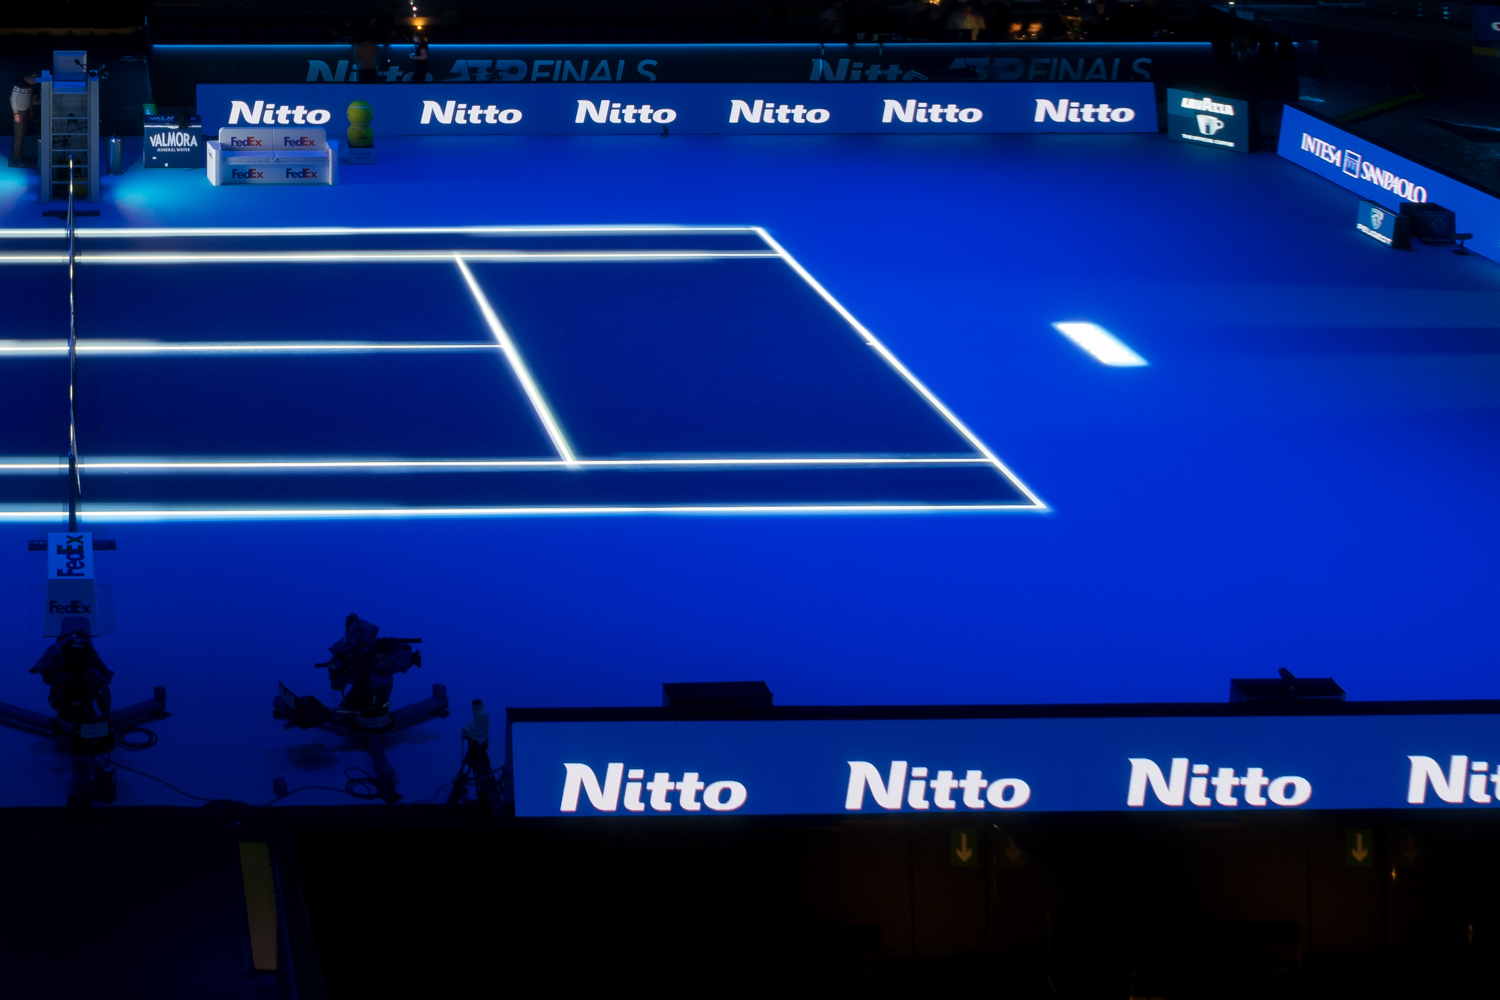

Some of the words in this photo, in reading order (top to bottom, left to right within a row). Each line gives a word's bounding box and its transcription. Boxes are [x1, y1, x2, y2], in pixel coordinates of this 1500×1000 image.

[228, 100, 331, 125] Nitto
[420, 100, 522, 125] Nitto
[575, 100, 677, 124] Nitto
[729, 100, 830, 124] Nitto
[882, 99, 984, 123] Nitto
[1034, 99, 1135, 123] Nitto
[149, 131, 198, 147] VALMORA
[231, 136, 262, 147] FedEx
[284, 136, 316, 147] FedEx
[232, 168, 264, 179] FedEx
[286, 167, 318, 179] FedEx
[1301, 133, 1343, 168] INTESA
[1360, 161, 1428, 203] SANPAOLO
[57, 535, 85, 577] FedEx
[49, 601, 91, 613] FedEx
[560, 763, 747, 811] Nitto
[845, 760, 1030, 810] Nitto
[1127, 757, 1312, 807] Nitto
